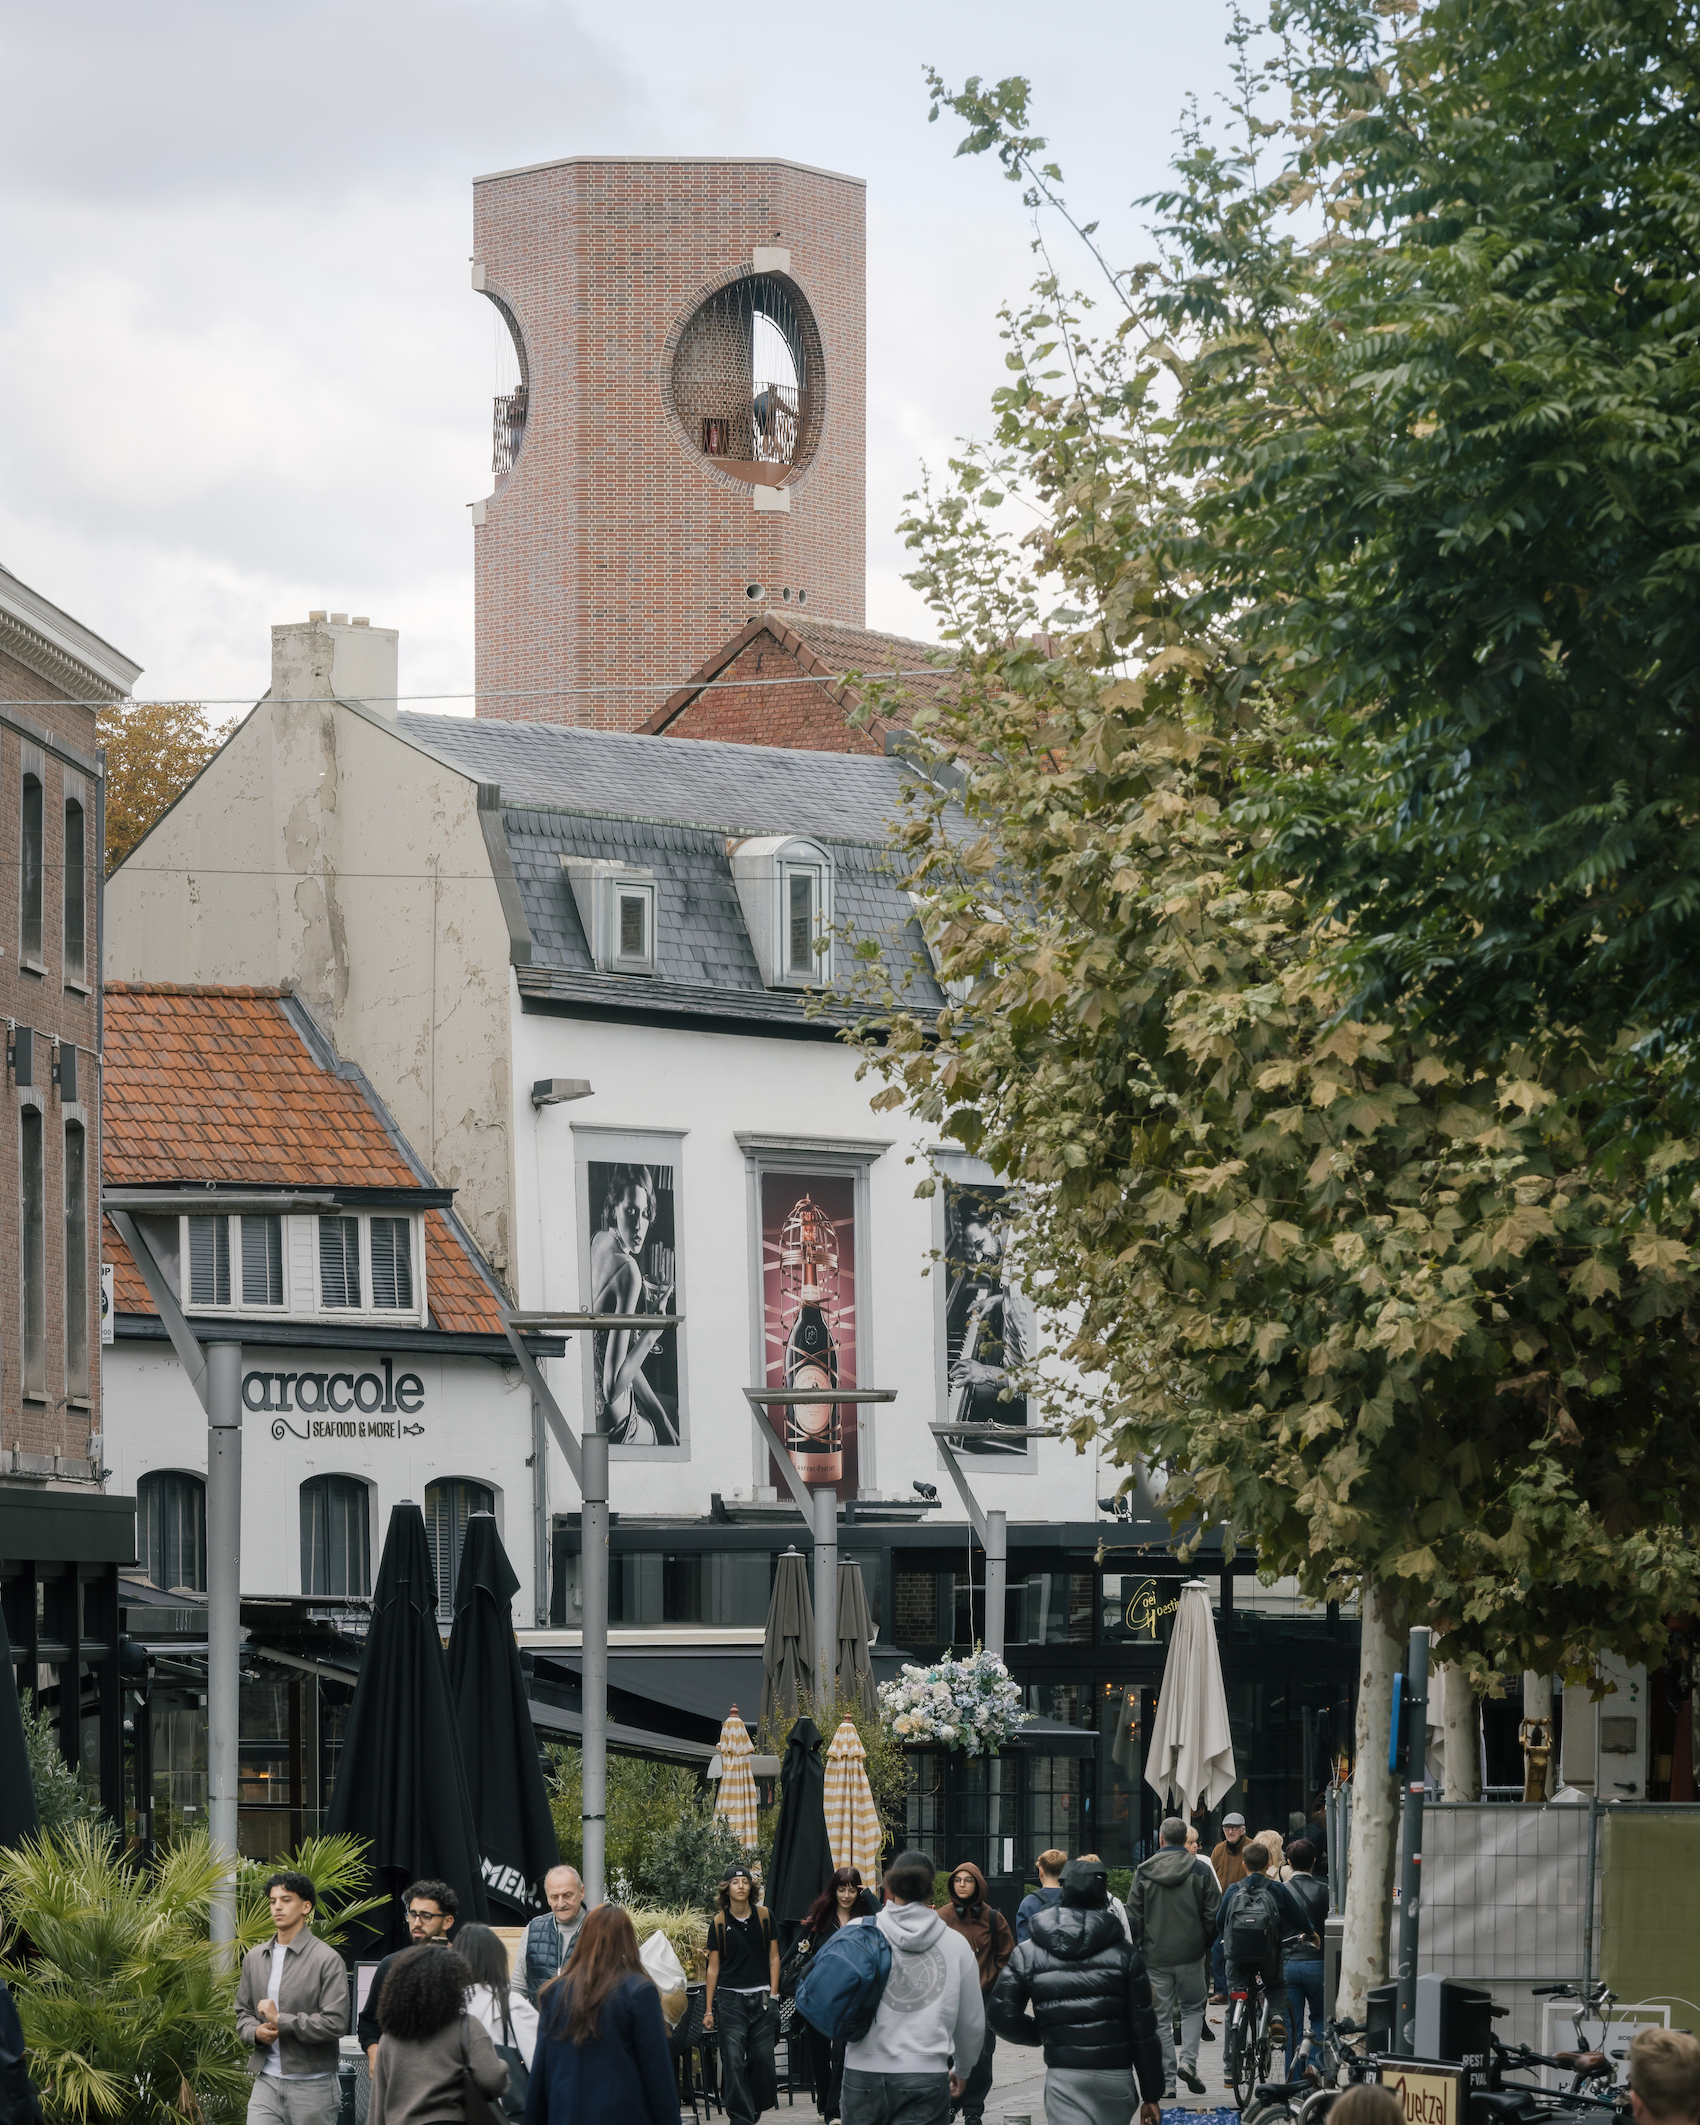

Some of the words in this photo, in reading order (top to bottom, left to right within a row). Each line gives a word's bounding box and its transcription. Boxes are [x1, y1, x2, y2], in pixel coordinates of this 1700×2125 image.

[313, 1421, 357, 1438] SEAFOOD
[359, 1421, 366, 1437] &
[368, 1421, 396, 1438] MORE
[478, 1855, 542, 1909] MER.
